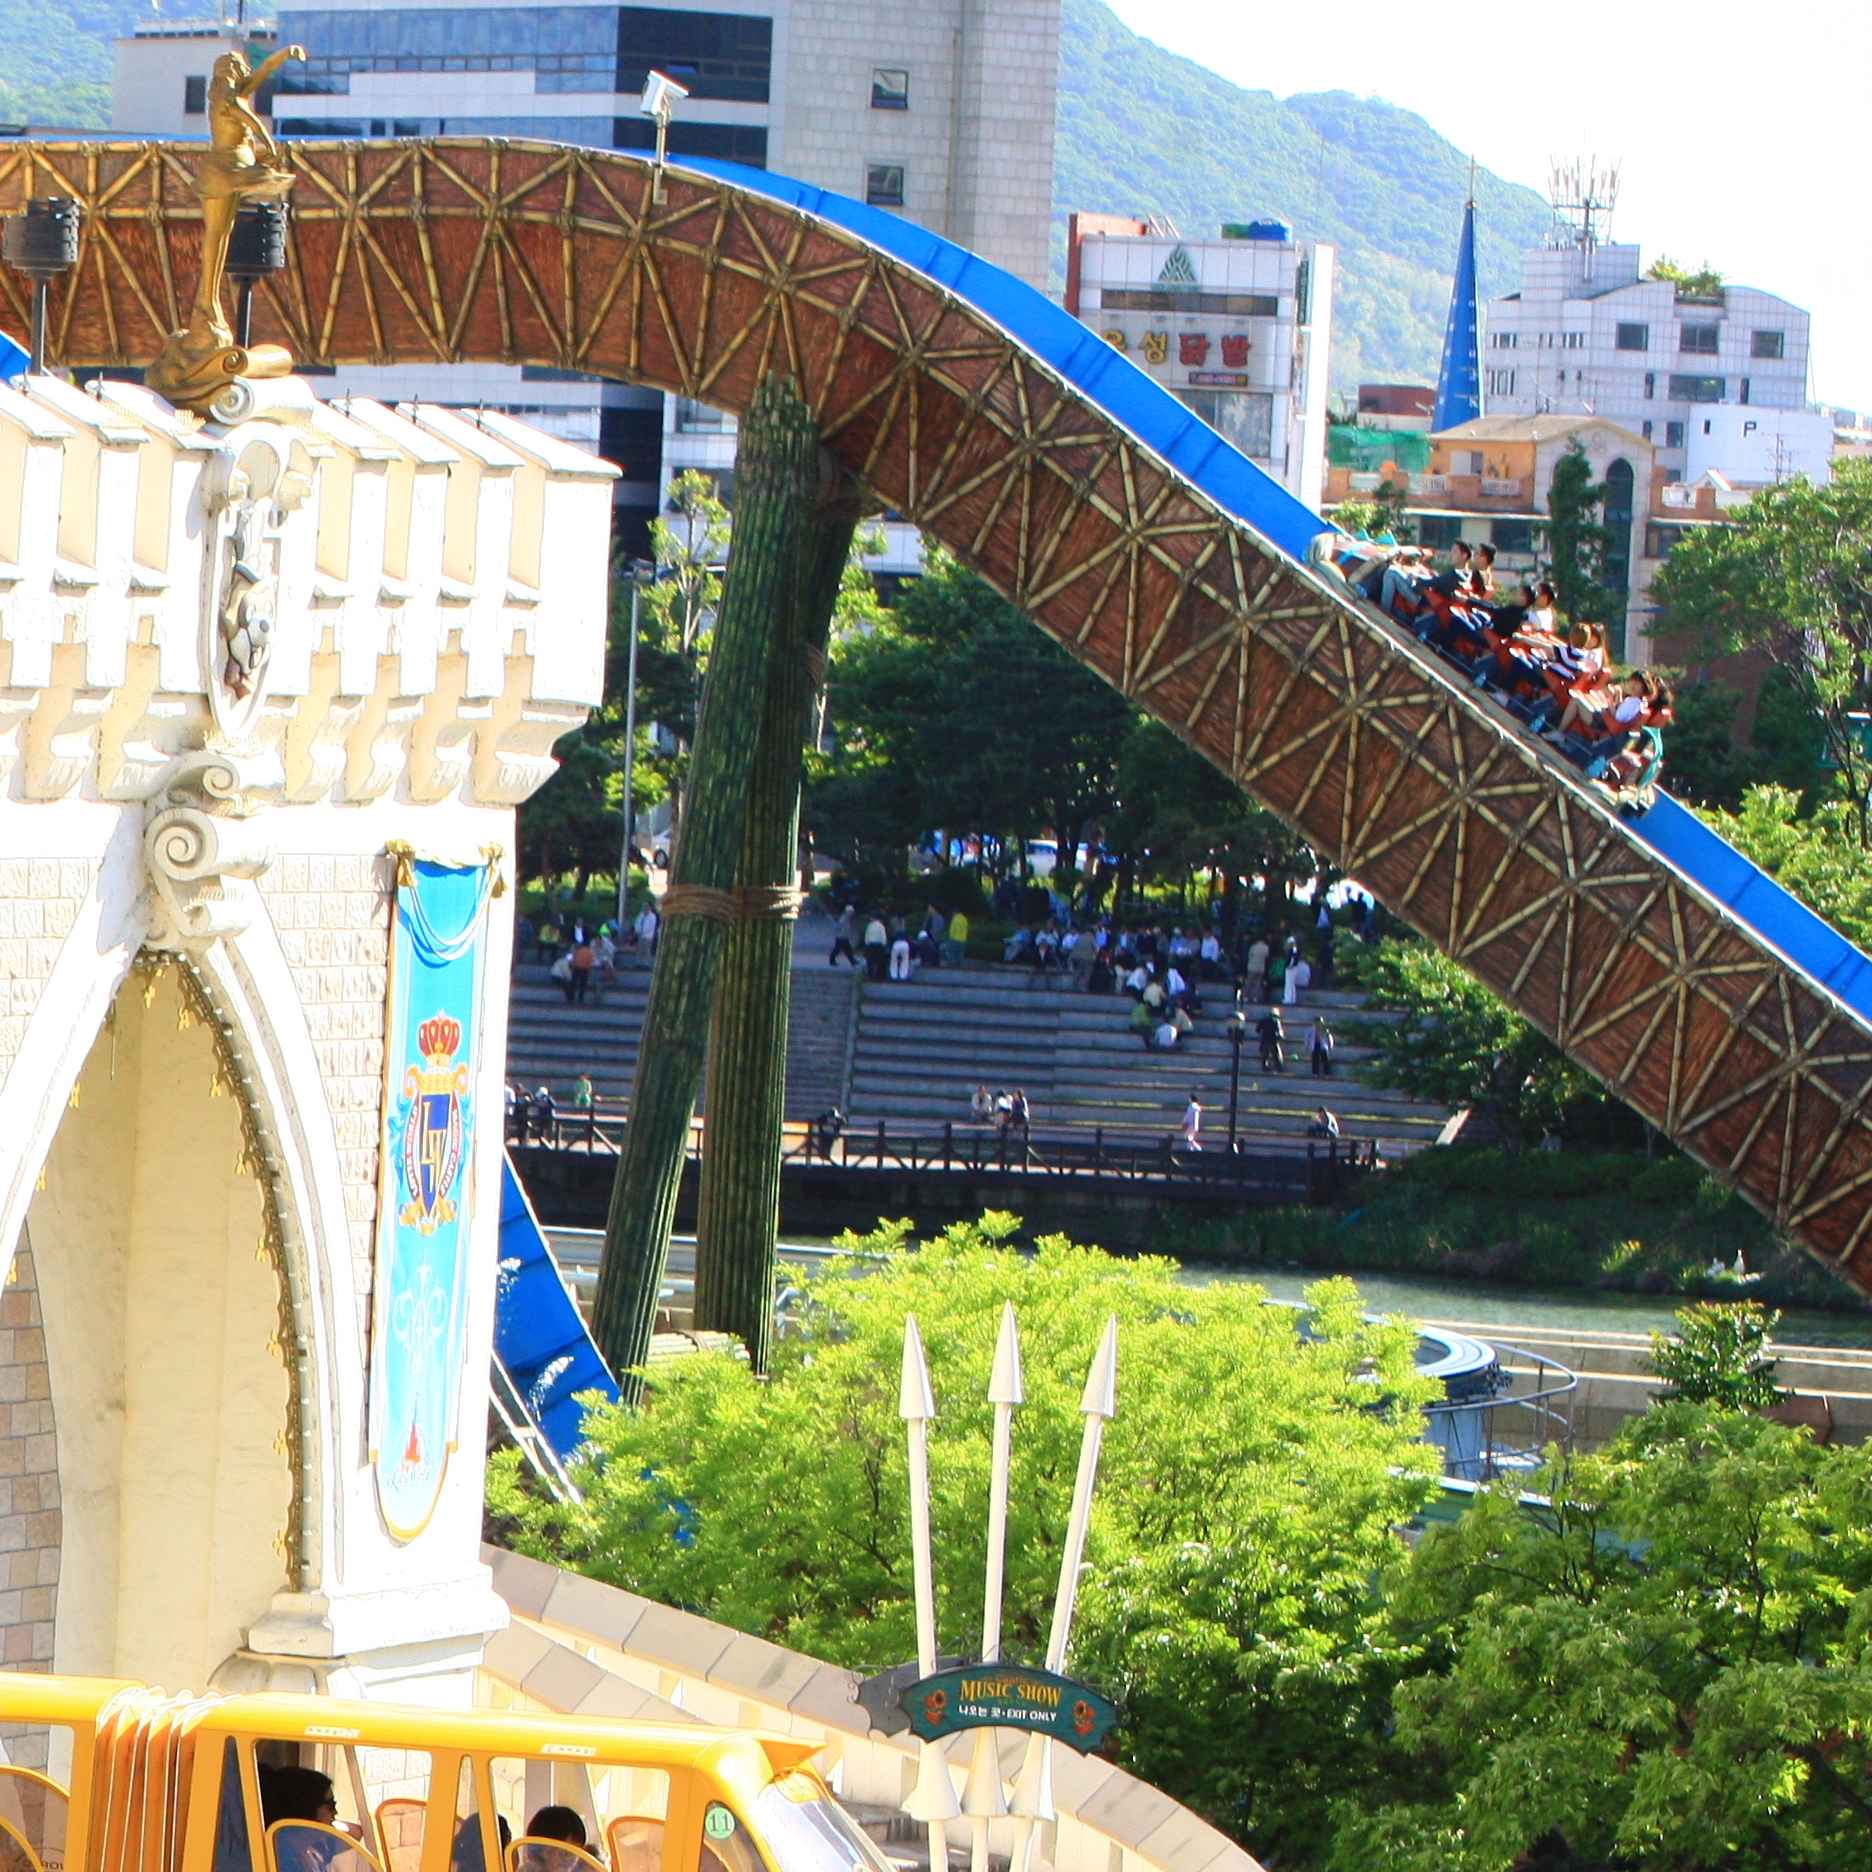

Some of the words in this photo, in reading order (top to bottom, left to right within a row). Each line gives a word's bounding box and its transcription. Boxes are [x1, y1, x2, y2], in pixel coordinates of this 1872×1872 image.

[960, 1679, 1010, 1701] MUSIC
[1017, 1683, 1062, 1707] SHOW
[958, 1704, 988, 1718] 나오는
[1029, 1710, 1057, 1722] ONLY
[709, 1813, 731, 1833] 11
